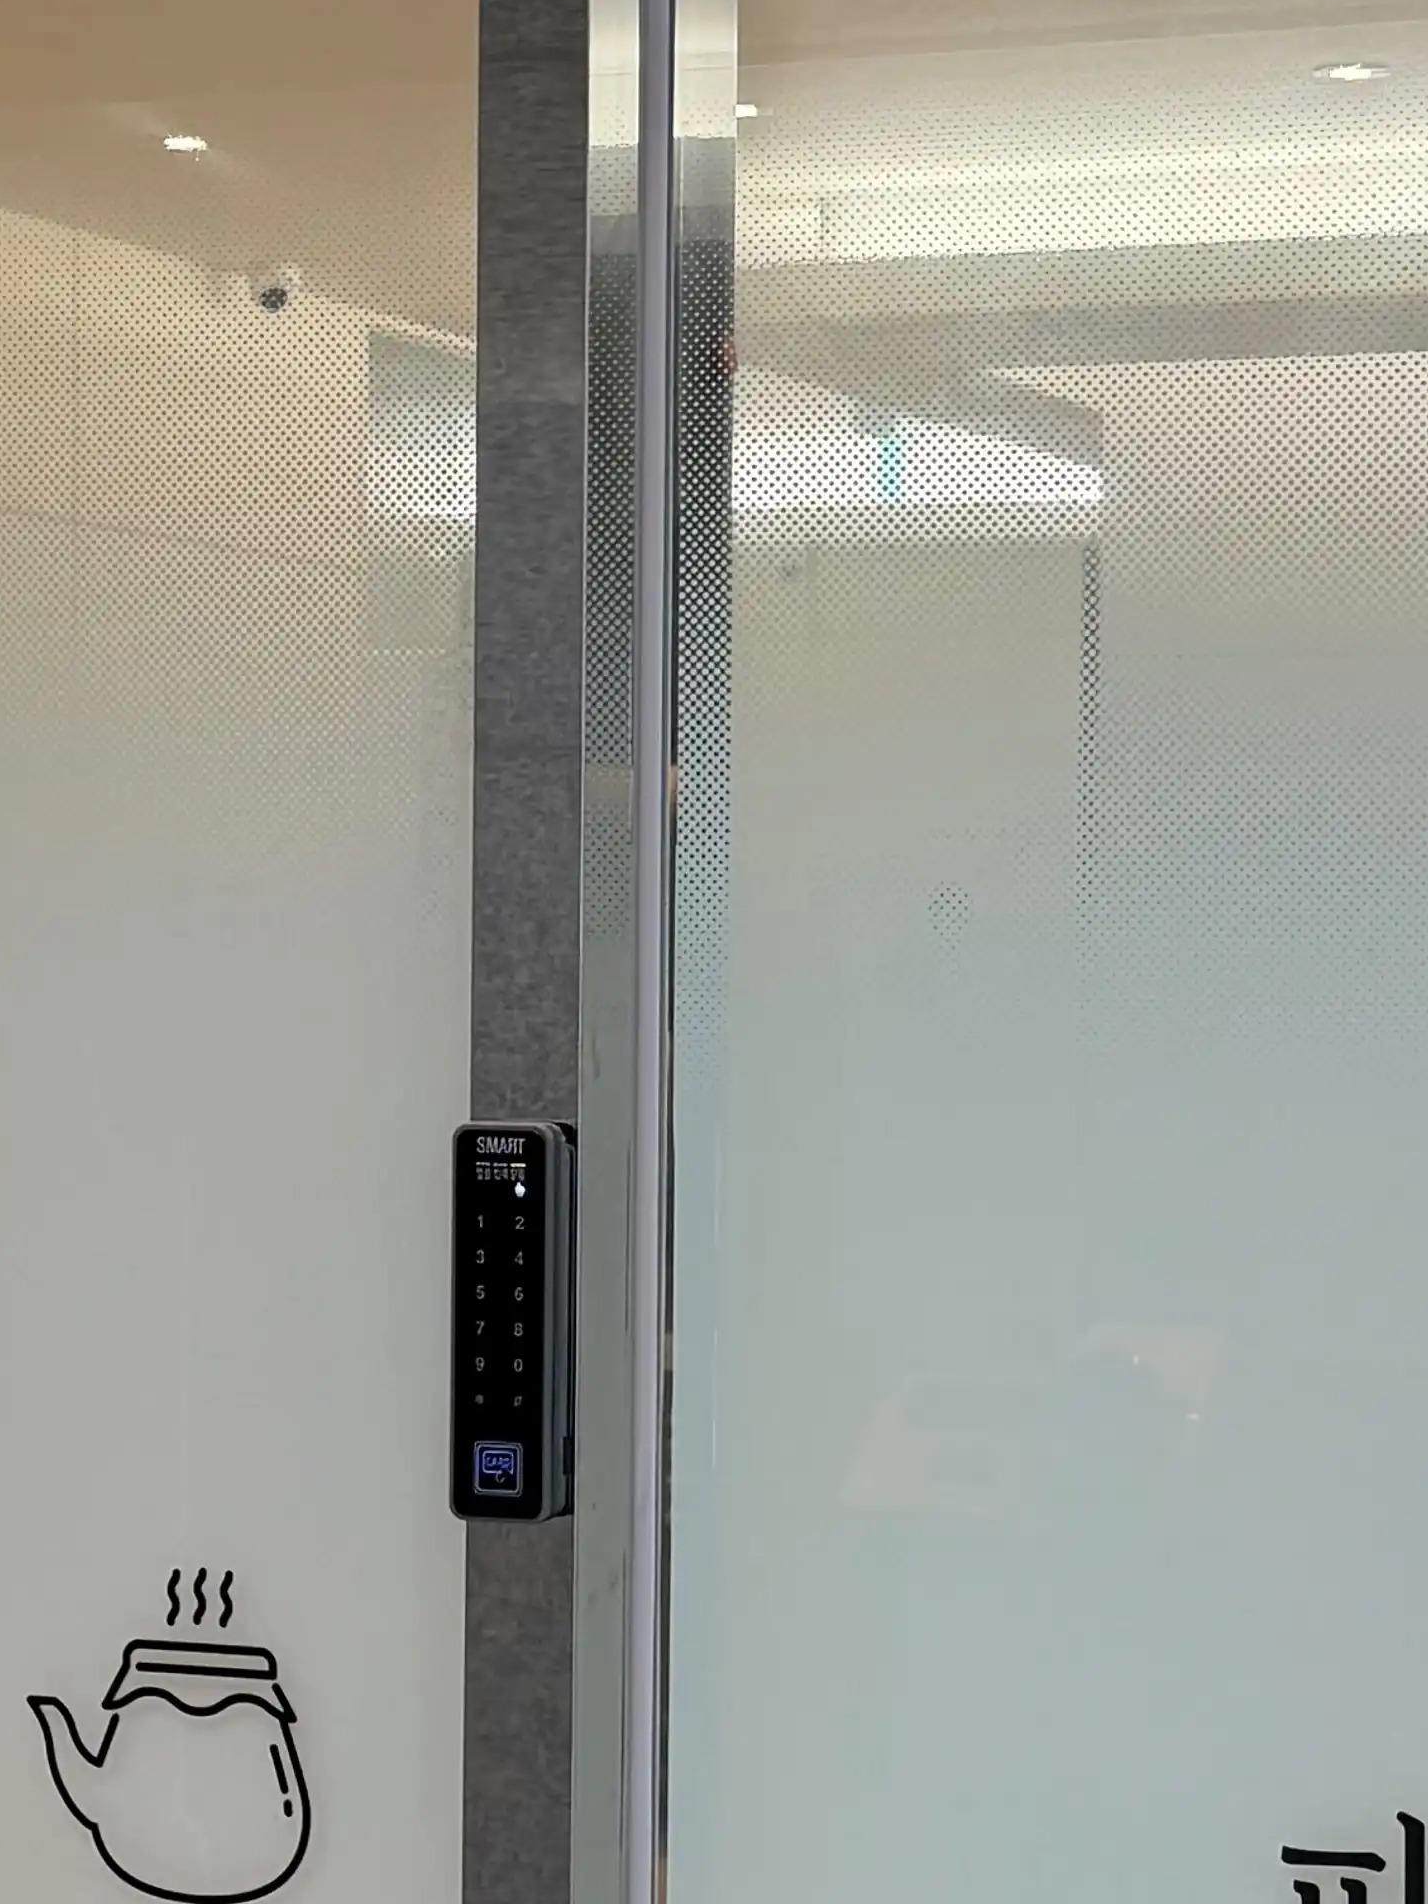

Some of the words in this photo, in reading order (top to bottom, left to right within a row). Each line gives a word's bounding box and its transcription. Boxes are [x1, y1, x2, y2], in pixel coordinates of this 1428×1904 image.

[476, 1136, 526, 1155] SMART
[477, 1214, 484, 1229] 1
[514, 1215, 525, 1230] 2
[475, 1248, 485, 1265] 3
[475, 1284, 486, 1300] 5
[514, 1286, 524, 1302] 6
[475, 1320, 485, 1336] 7
[513, 1322, 524, 1337] 8
[475, 1356, 485, 1372] 9
